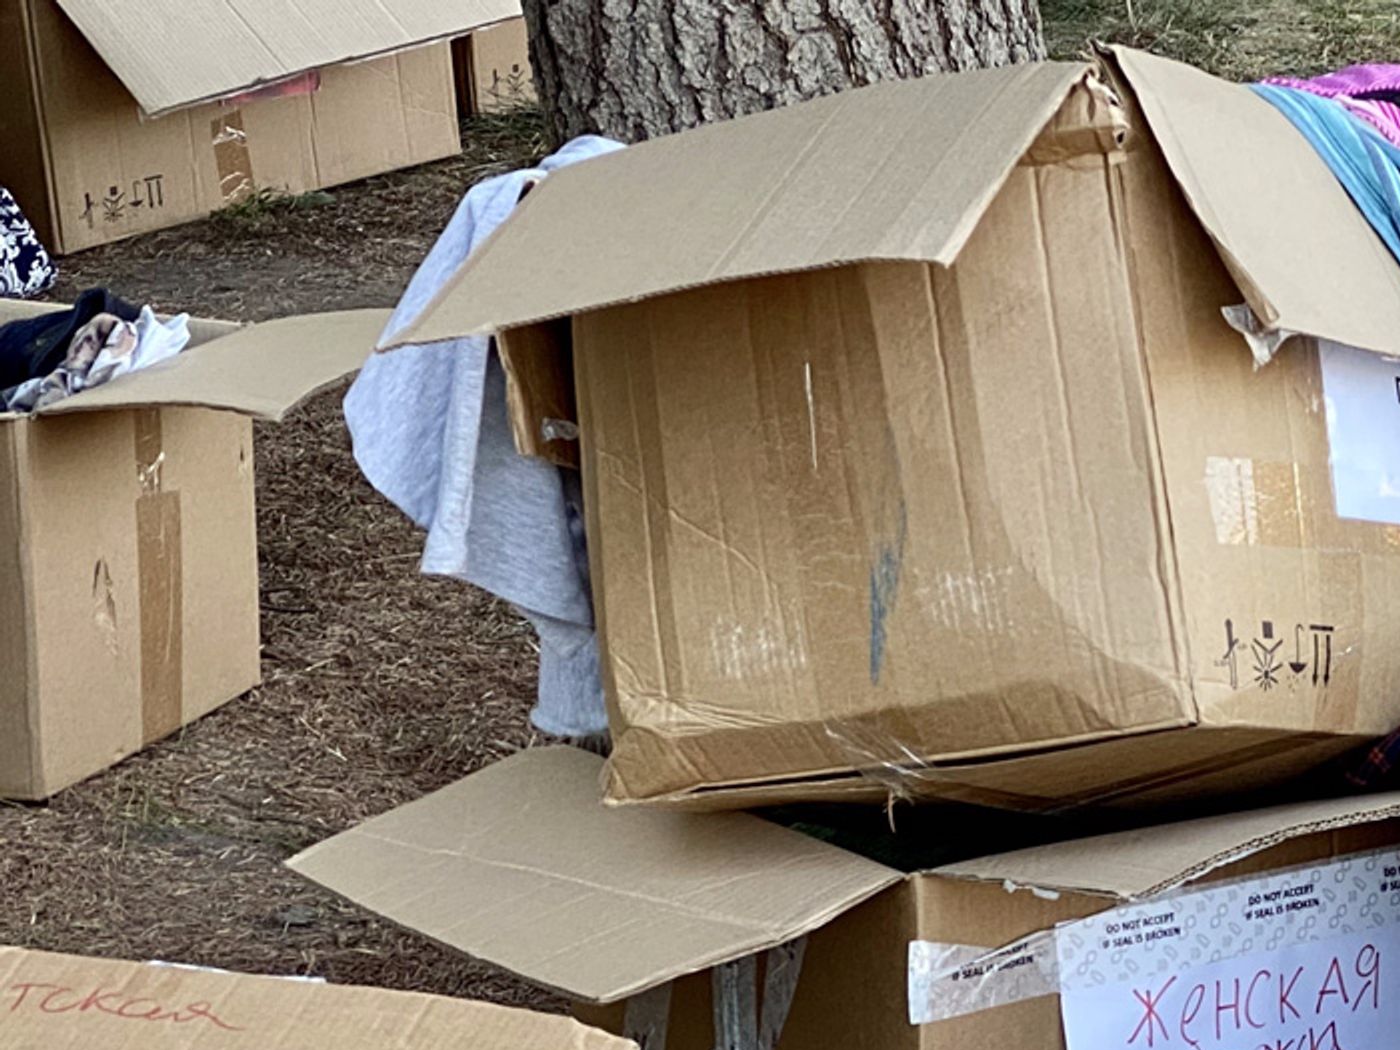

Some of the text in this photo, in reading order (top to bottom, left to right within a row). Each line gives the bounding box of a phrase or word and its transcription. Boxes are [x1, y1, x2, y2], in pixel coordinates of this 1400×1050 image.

[1383, 866, 1397, 878] DO
[1248, 883, 1314, 906] DO NOT ACCEPT
[1254, 906, 1274, 919] SEAL
[1286, 898, 1319, 911] BROKEN
[1106, 912, 1174, 934] DO NOT ACCEPT
[1113, 936, 1133, 947] SEAL
[1145, 926, 1181, 941] BROKEN
